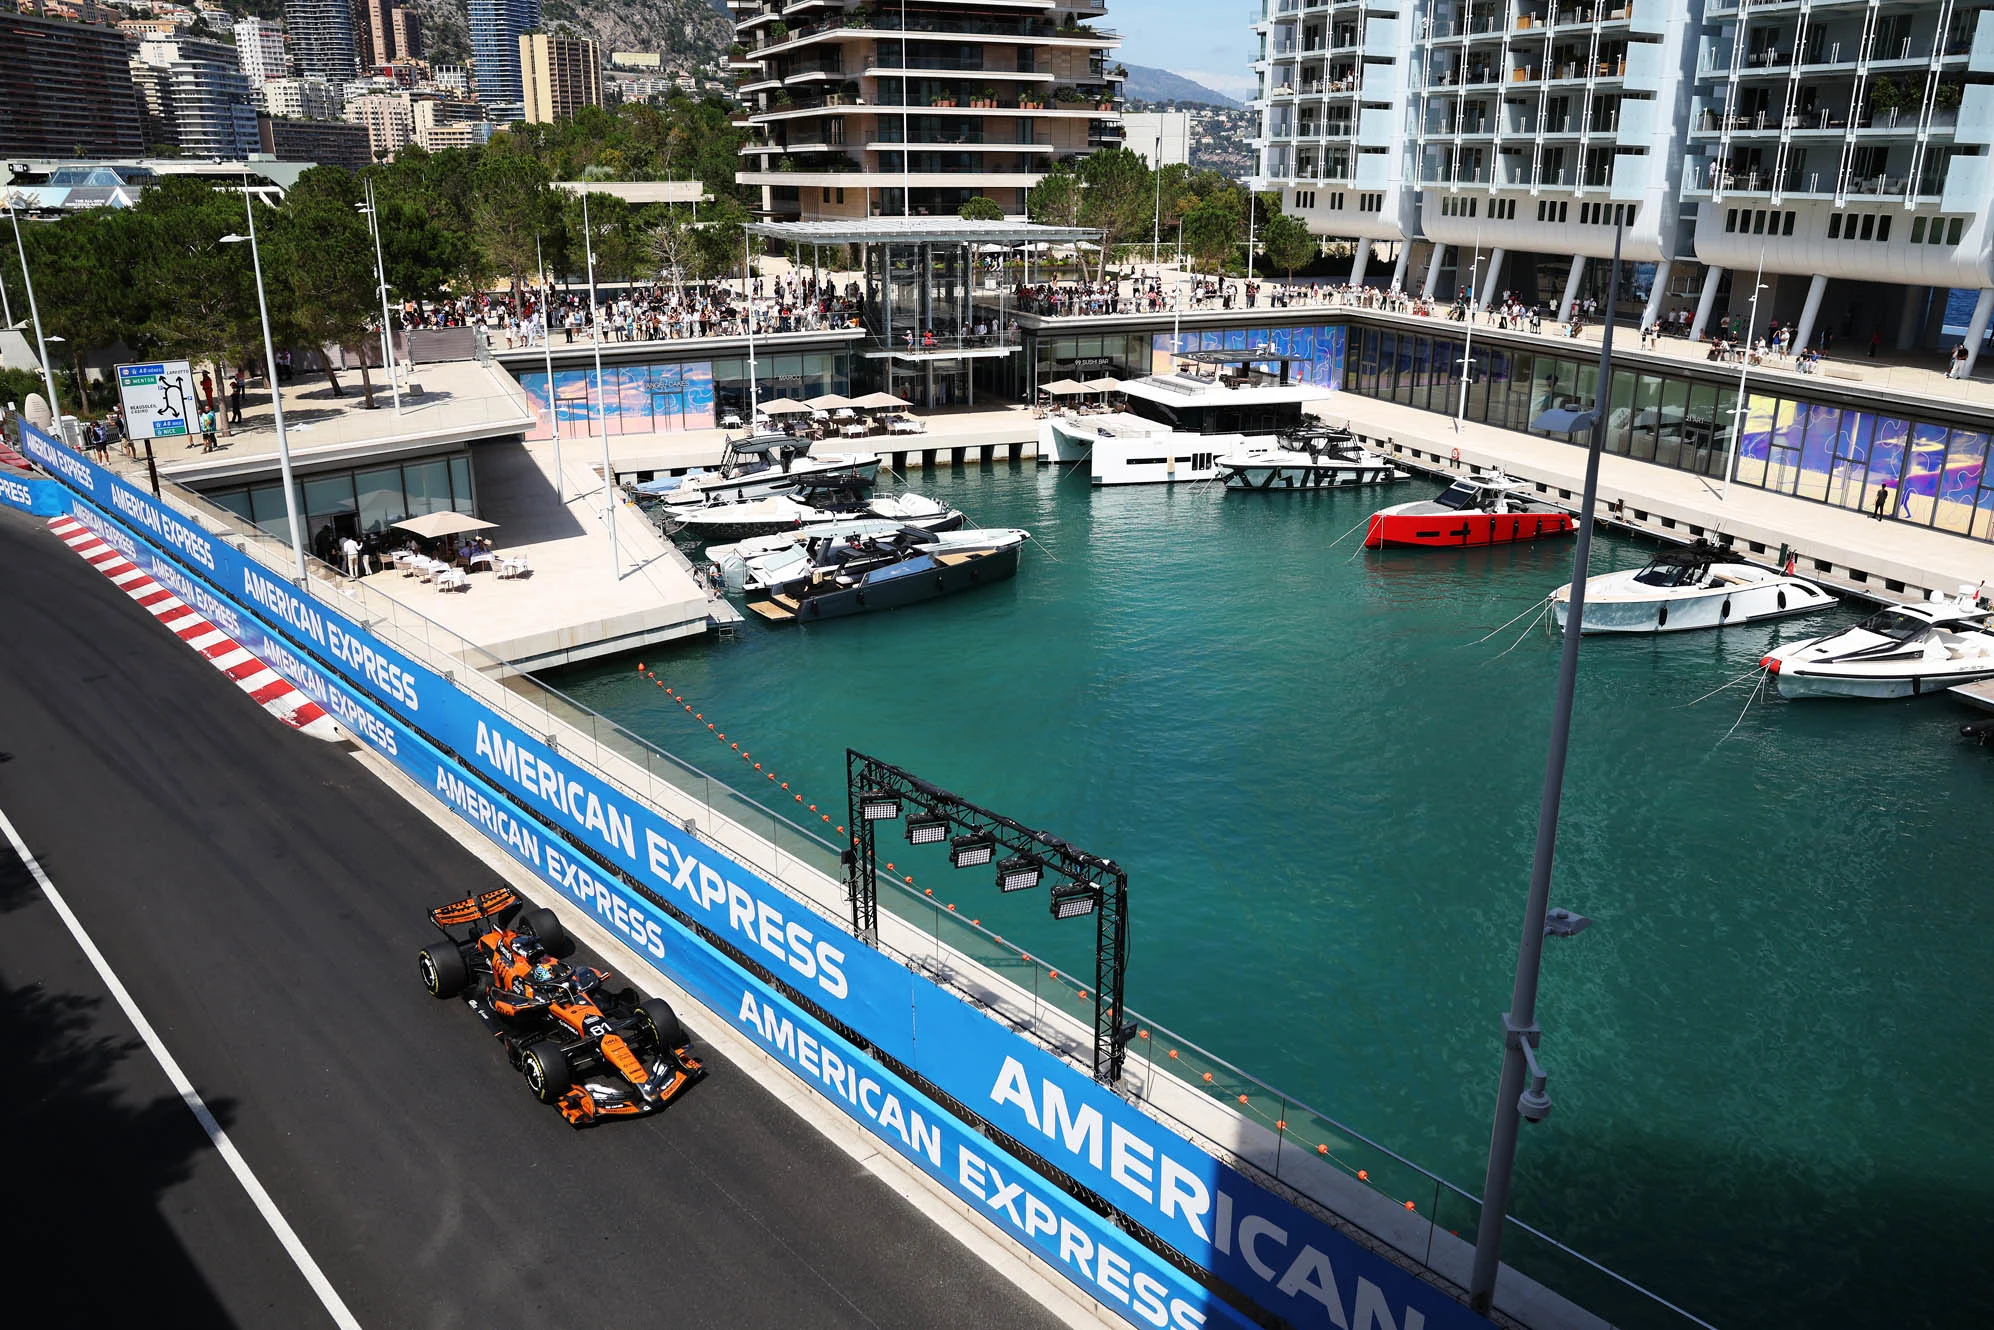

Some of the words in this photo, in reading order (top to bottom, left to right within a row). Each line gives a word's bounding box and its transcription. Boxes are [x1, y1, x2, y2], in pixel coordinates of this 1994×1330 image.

[0, 478, 32, 505] PRESS
[26, 430, 60, 468] AMERICAN
[57, 450, 94, 491] EXPRESS
[72, 499, 105, 536] AMERICAN
[103, 521, 137, 559] EXPRESS
[111, 482, 163, 535] AMERICAN
[160, 514, 214, 571] EXPRESS
[151, 555, 197, 605] AMERICAN
[195, 586, 241, 635] EXPRESS
[243, 567, 325, 646] AMERICAN
[327, 621, 419, 711] EXPRESS
[262, 635, 328, 704] AMERICAN
[327, 684, 398, 756] EXPRESS
[436, 766, 541, 867] AMERICAN
[545, 844, 666, 959] EXPRESS
[475, 719, 637, 860] AMERICAN
[646, 828, 849, 1000] EXPRESS
[590, 1022, 612, 1036] 81
[738, 990, 941, 1168] AMERICAN
[958, 1144, 1208, 1330] EXPRESS
[990, 1056, 1425, 1330] AMERICAN
